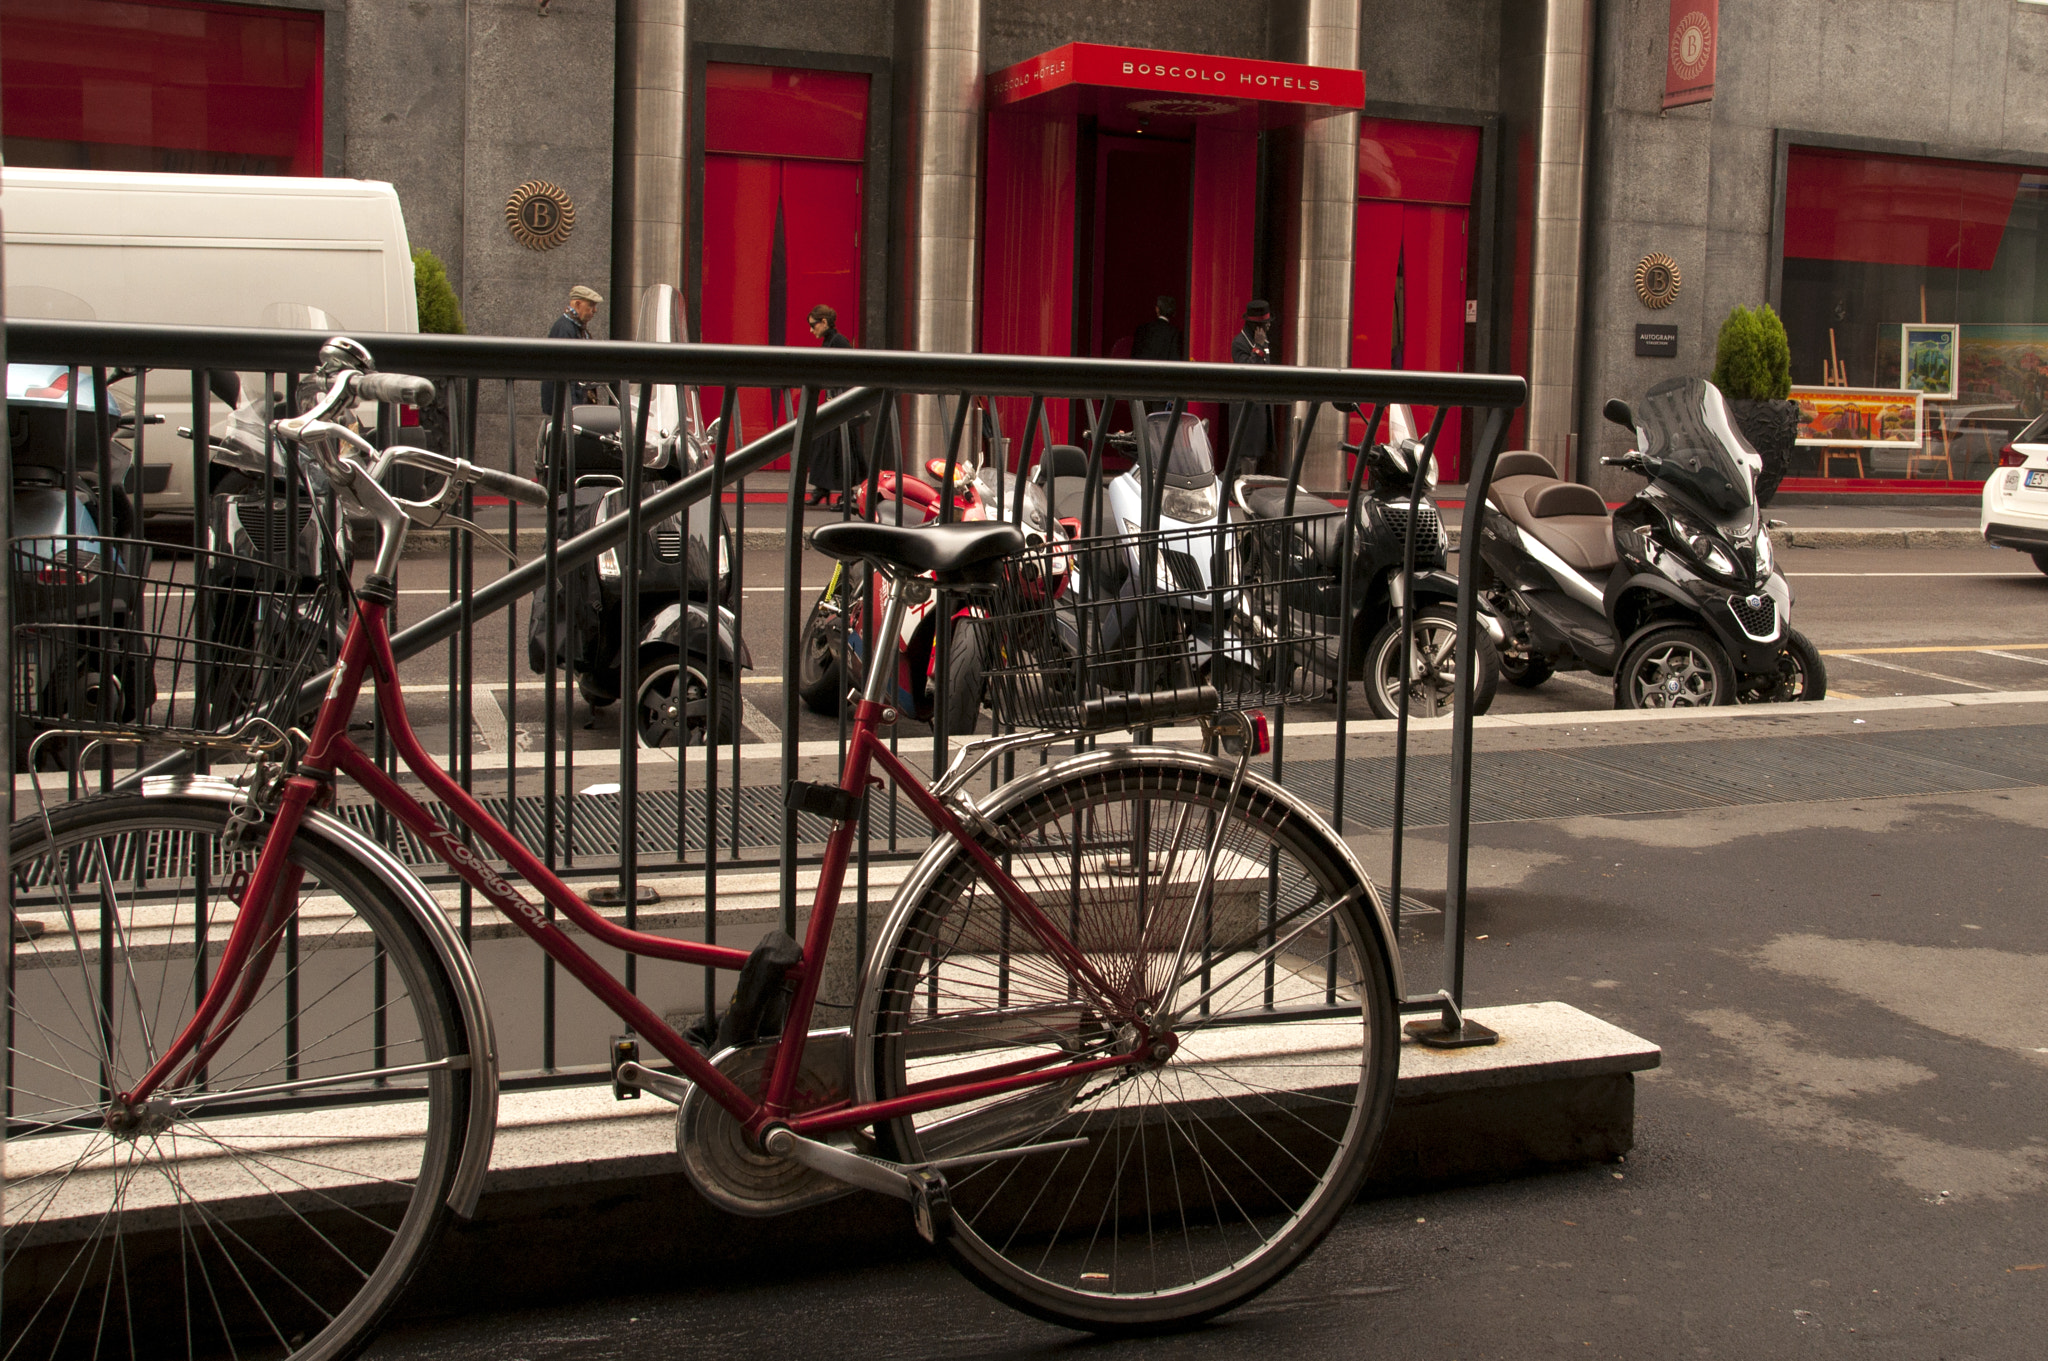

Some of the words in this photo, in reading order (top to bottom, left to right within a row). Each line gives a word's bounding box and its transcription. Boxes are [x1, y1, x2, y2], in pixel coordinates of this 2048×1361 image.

[1687, 34, 1697, 57] B
[1033, 60, 1066, 81] HOTELS
[1122, 61, 1226, 82] BOSCOLO
[1240, 72, 1320, 91] HOTELS
[531, 202, 551, 228] B
[1652, 269, 1666, 291] B
[429, 821, 549, 929] Rossignoli
